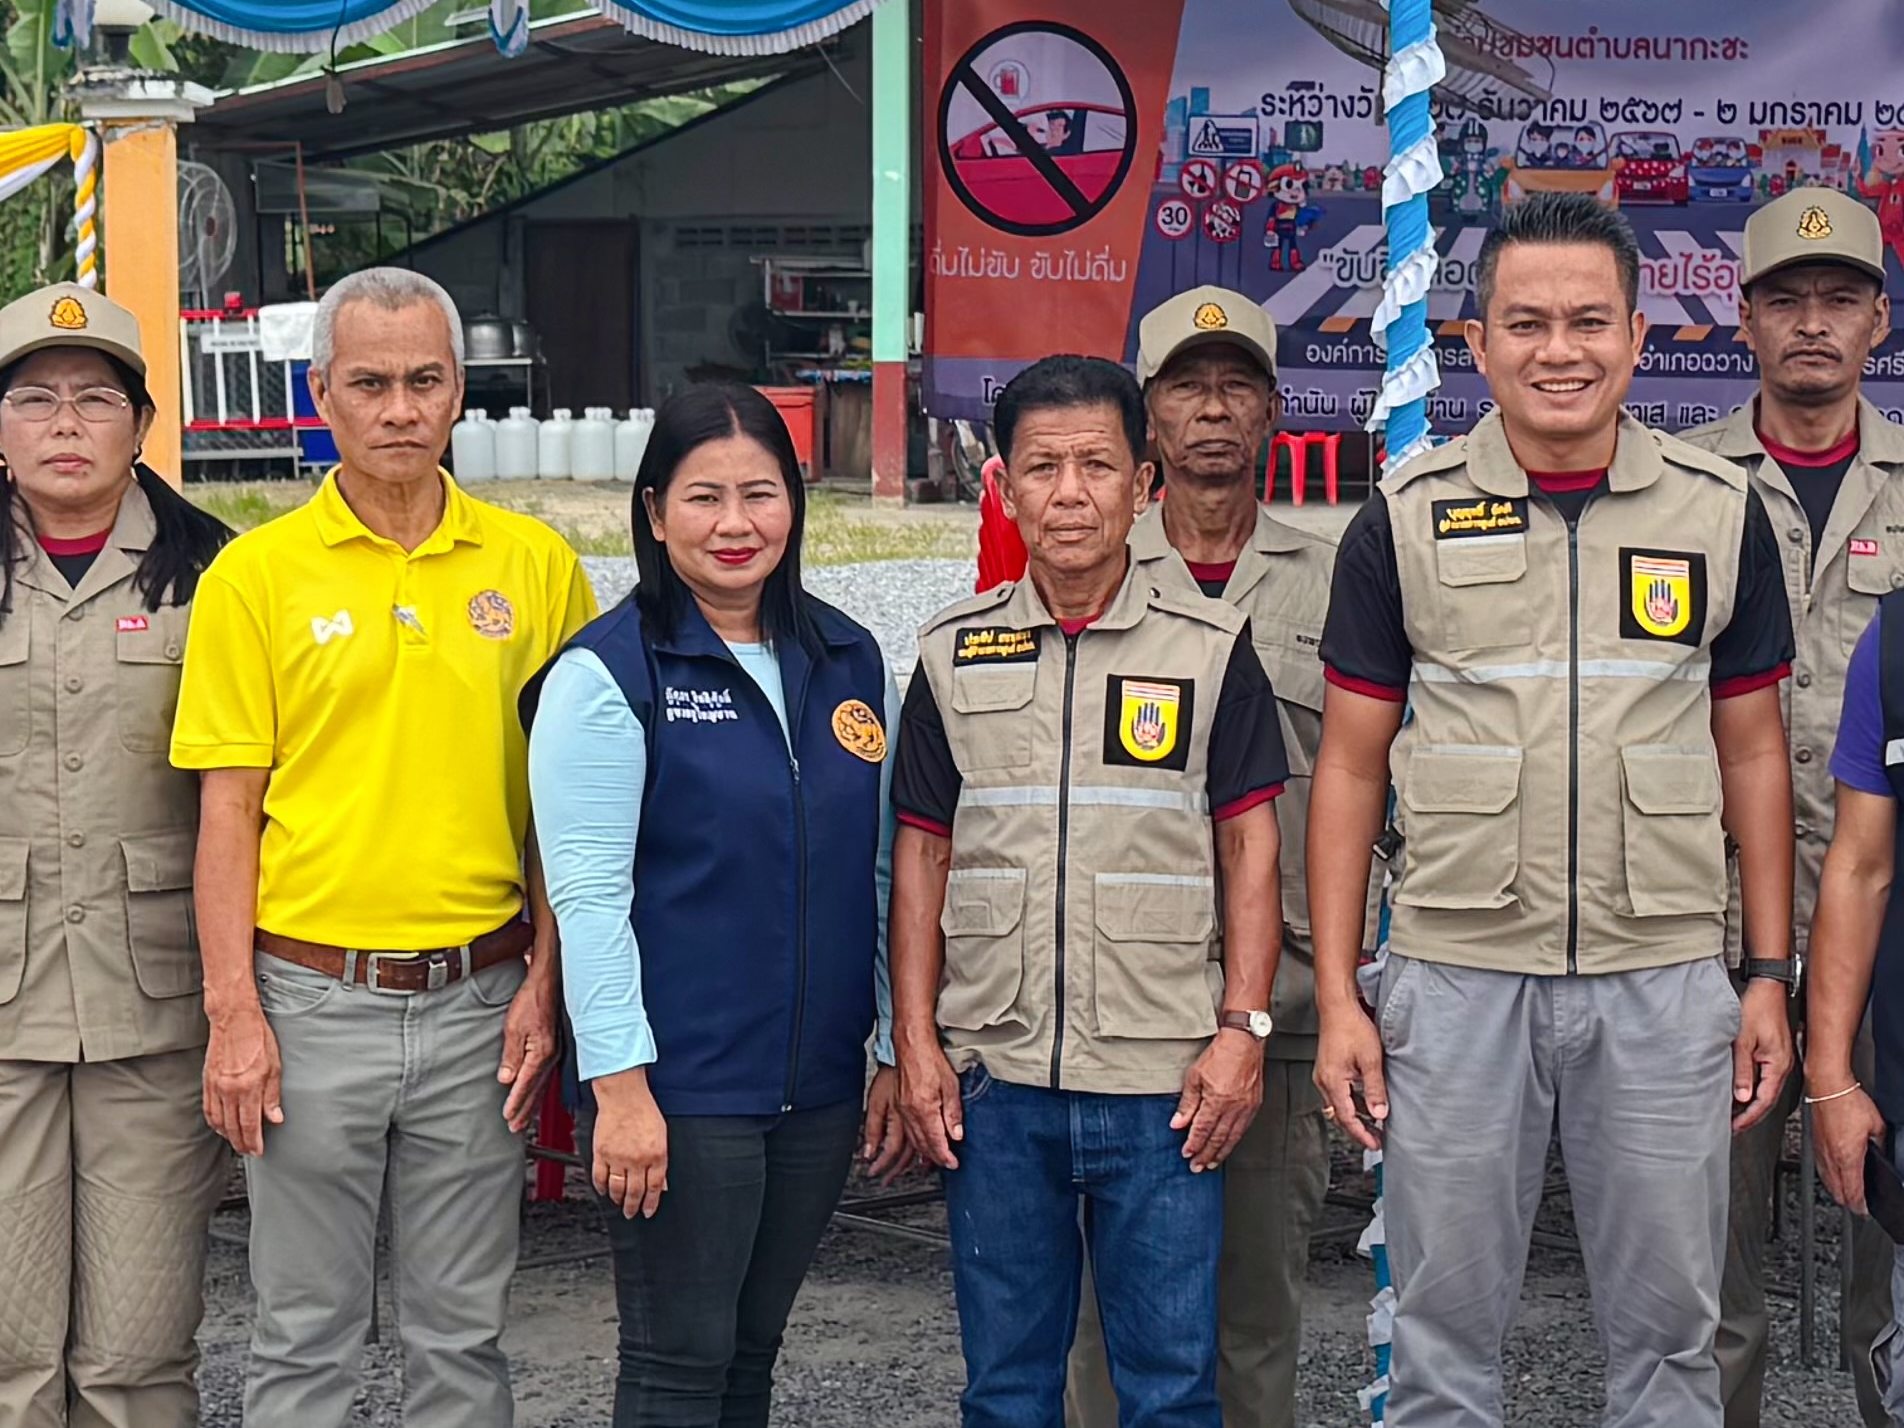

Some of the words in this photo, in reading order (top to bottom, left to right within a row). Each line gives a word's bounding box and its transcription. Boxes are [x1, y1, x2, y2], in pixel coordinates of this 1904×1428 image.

[1716, 100, 1737, 126] ๒
[1749, 101, 1863, 128] มกราคม
[1161, 206, 1188, 226] 30
[930, 239, 1020, 279] ดื่มไม่ขับ
[1030, 245, 1127, 282] ขับไม่ดื่ม
[1639, 344, 1754, 373] อำเภอฉวาง
